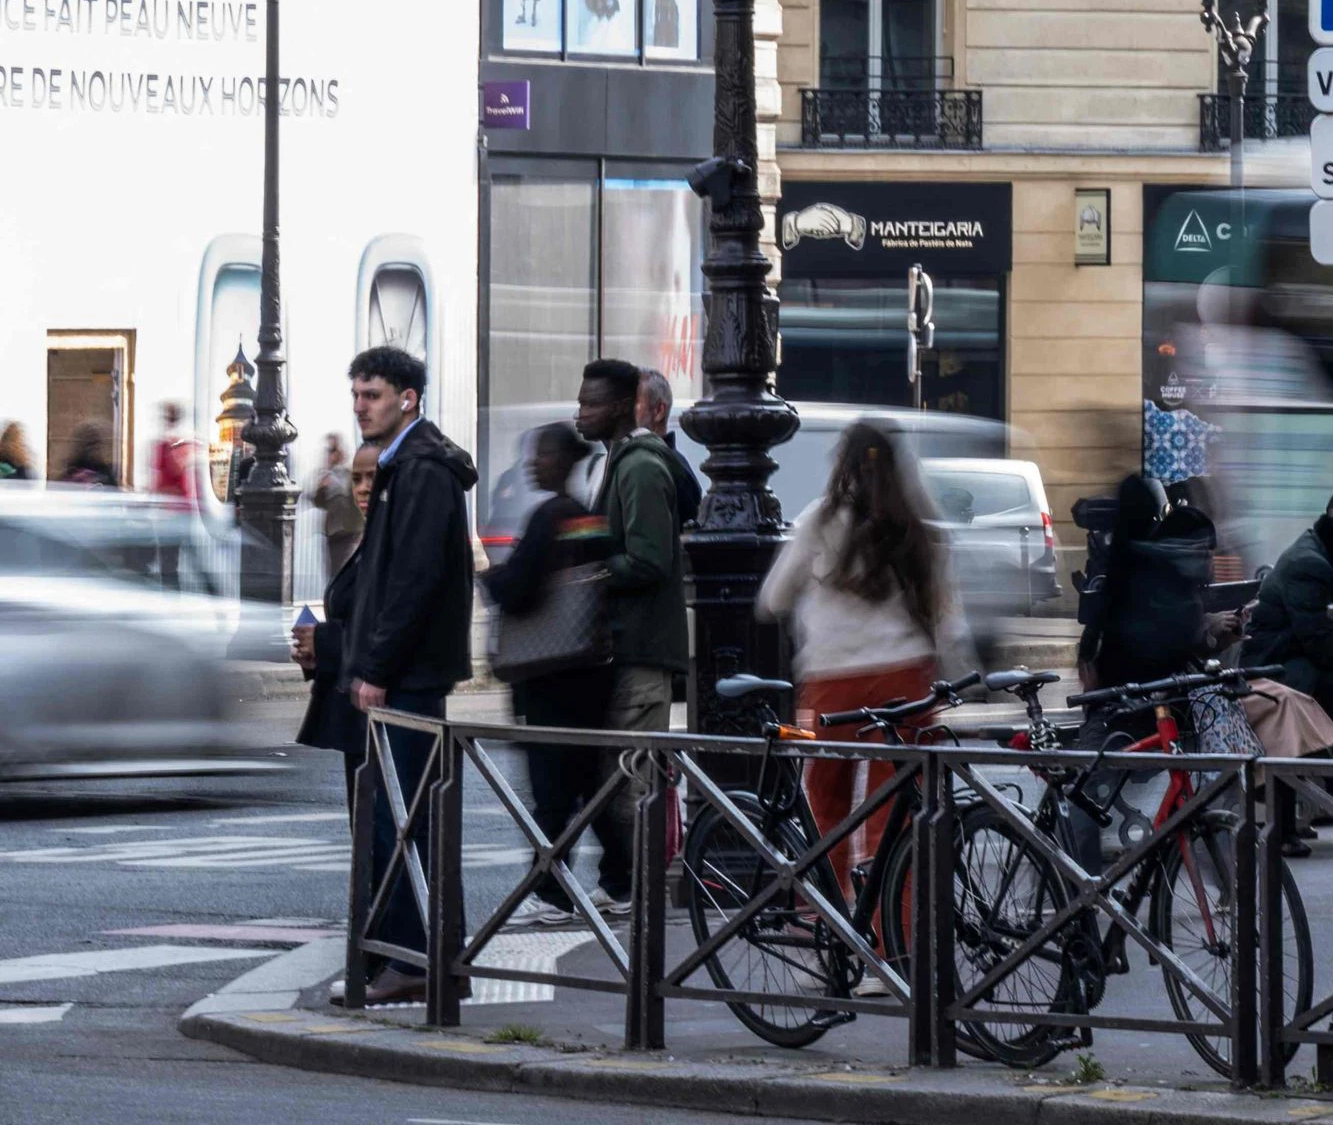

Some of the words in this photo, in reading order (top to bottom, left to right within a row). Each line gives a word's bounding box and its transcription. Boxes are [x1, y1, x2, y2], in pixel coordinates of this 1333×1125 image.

[177, 1, 258, 42] NEUVE
[32, 68, 62, 109] DE
[70, 70, 214, 115] NOUVEAUX
[221, 77, 339, 118] HORZONS
[871, 220, 984, 237] MANTEIGARIA
[1182, 233, 1206, 243] DELTA
